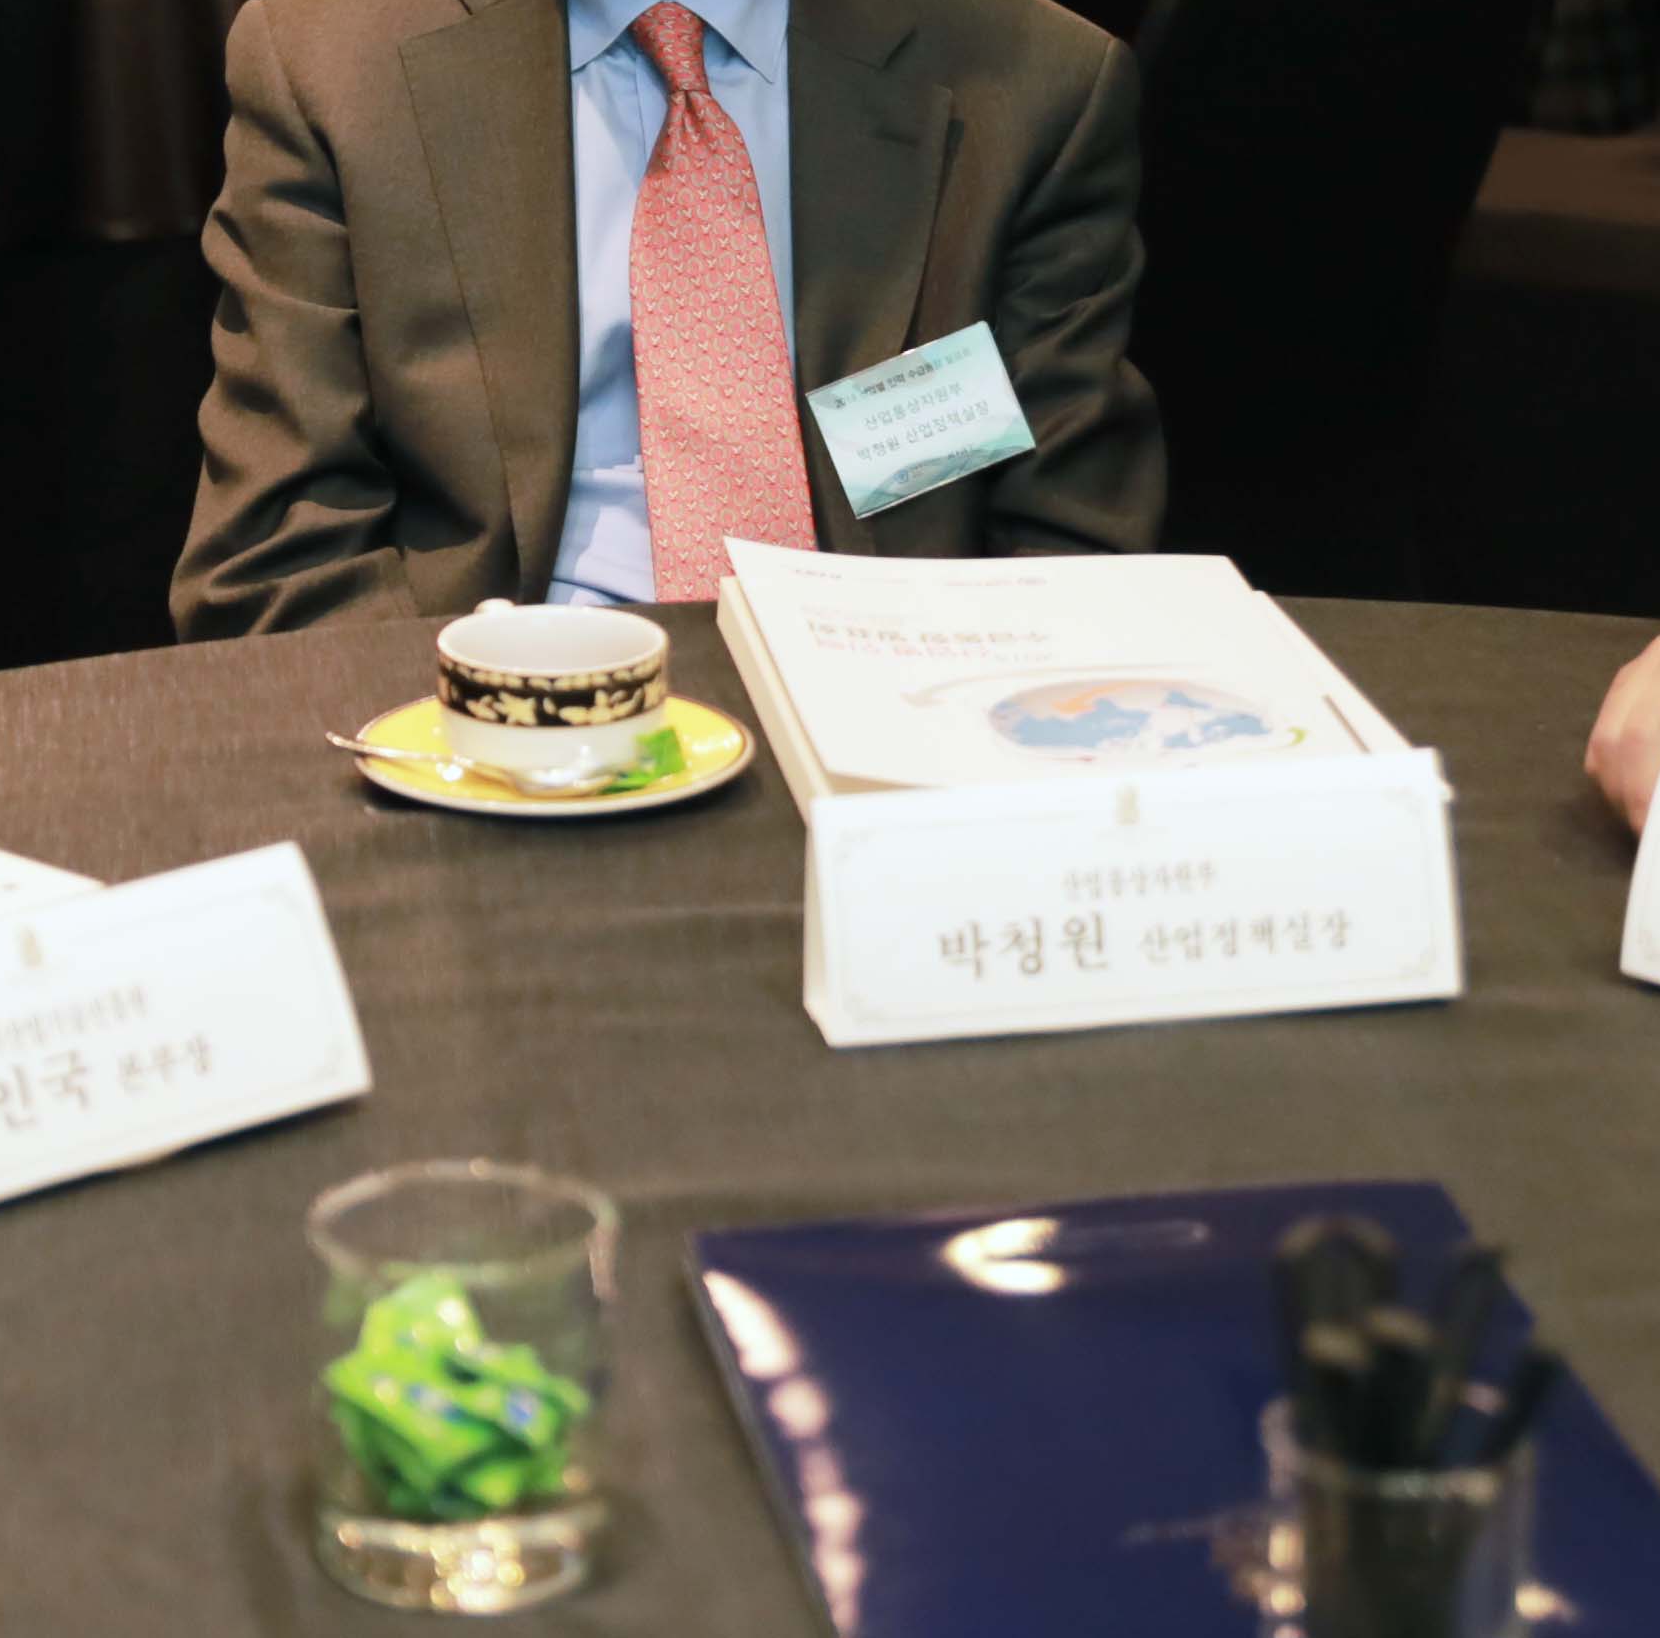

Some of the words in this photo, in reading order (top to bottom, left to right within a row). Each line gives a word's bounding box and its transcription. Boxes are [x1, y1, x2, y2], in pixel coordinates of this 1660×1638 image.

[863, 381, 962, 431] 산업통상자원부
[905, 400, 989, 444] 산업정책실장
[938, 910, 1110, 978] 박청원
[1138, 907, 1352, 967] 산업정책실장
